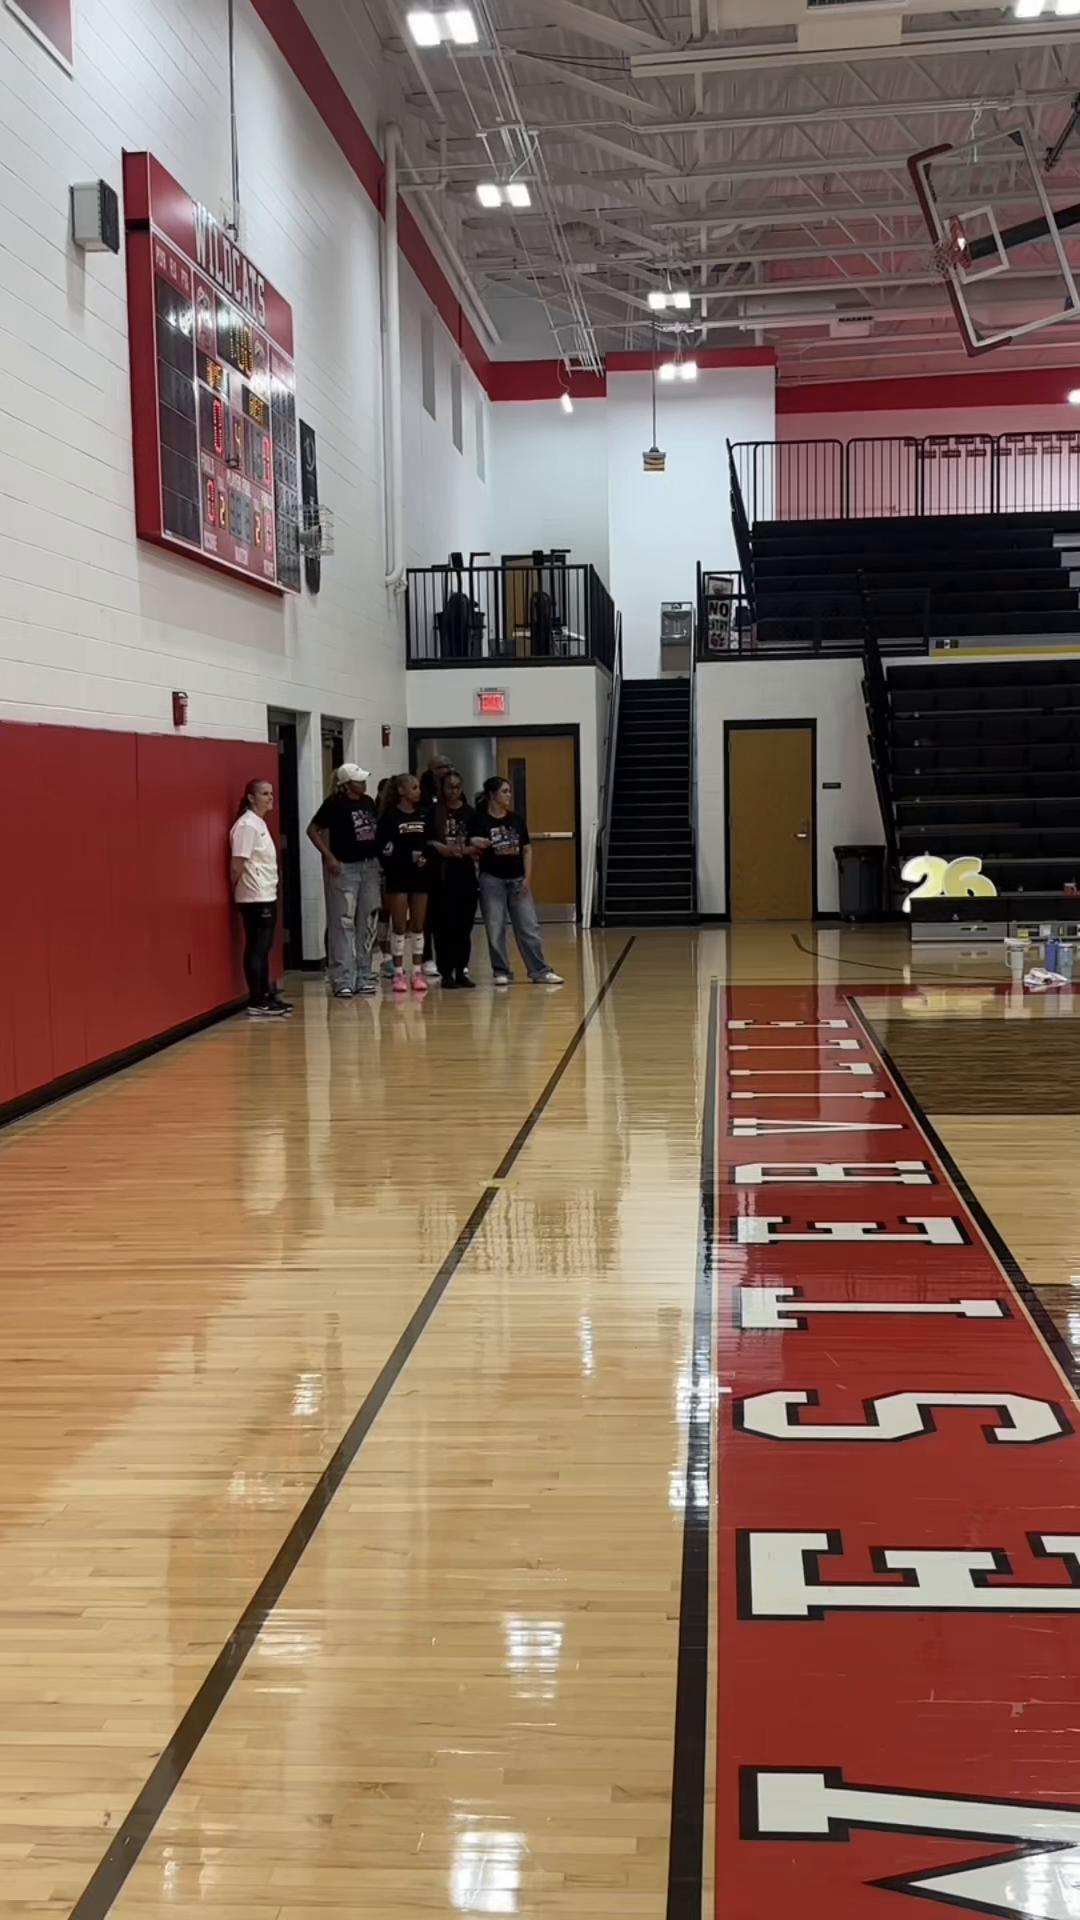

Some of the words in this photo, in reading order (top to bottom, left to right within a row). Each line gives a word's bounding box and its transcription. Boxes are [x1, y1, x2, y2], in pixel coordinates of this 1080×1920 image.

[192, 200, 266, 328] WILDCATS
[709, 602, 728, 617] NO
[901, 855, 998, 913] 26
